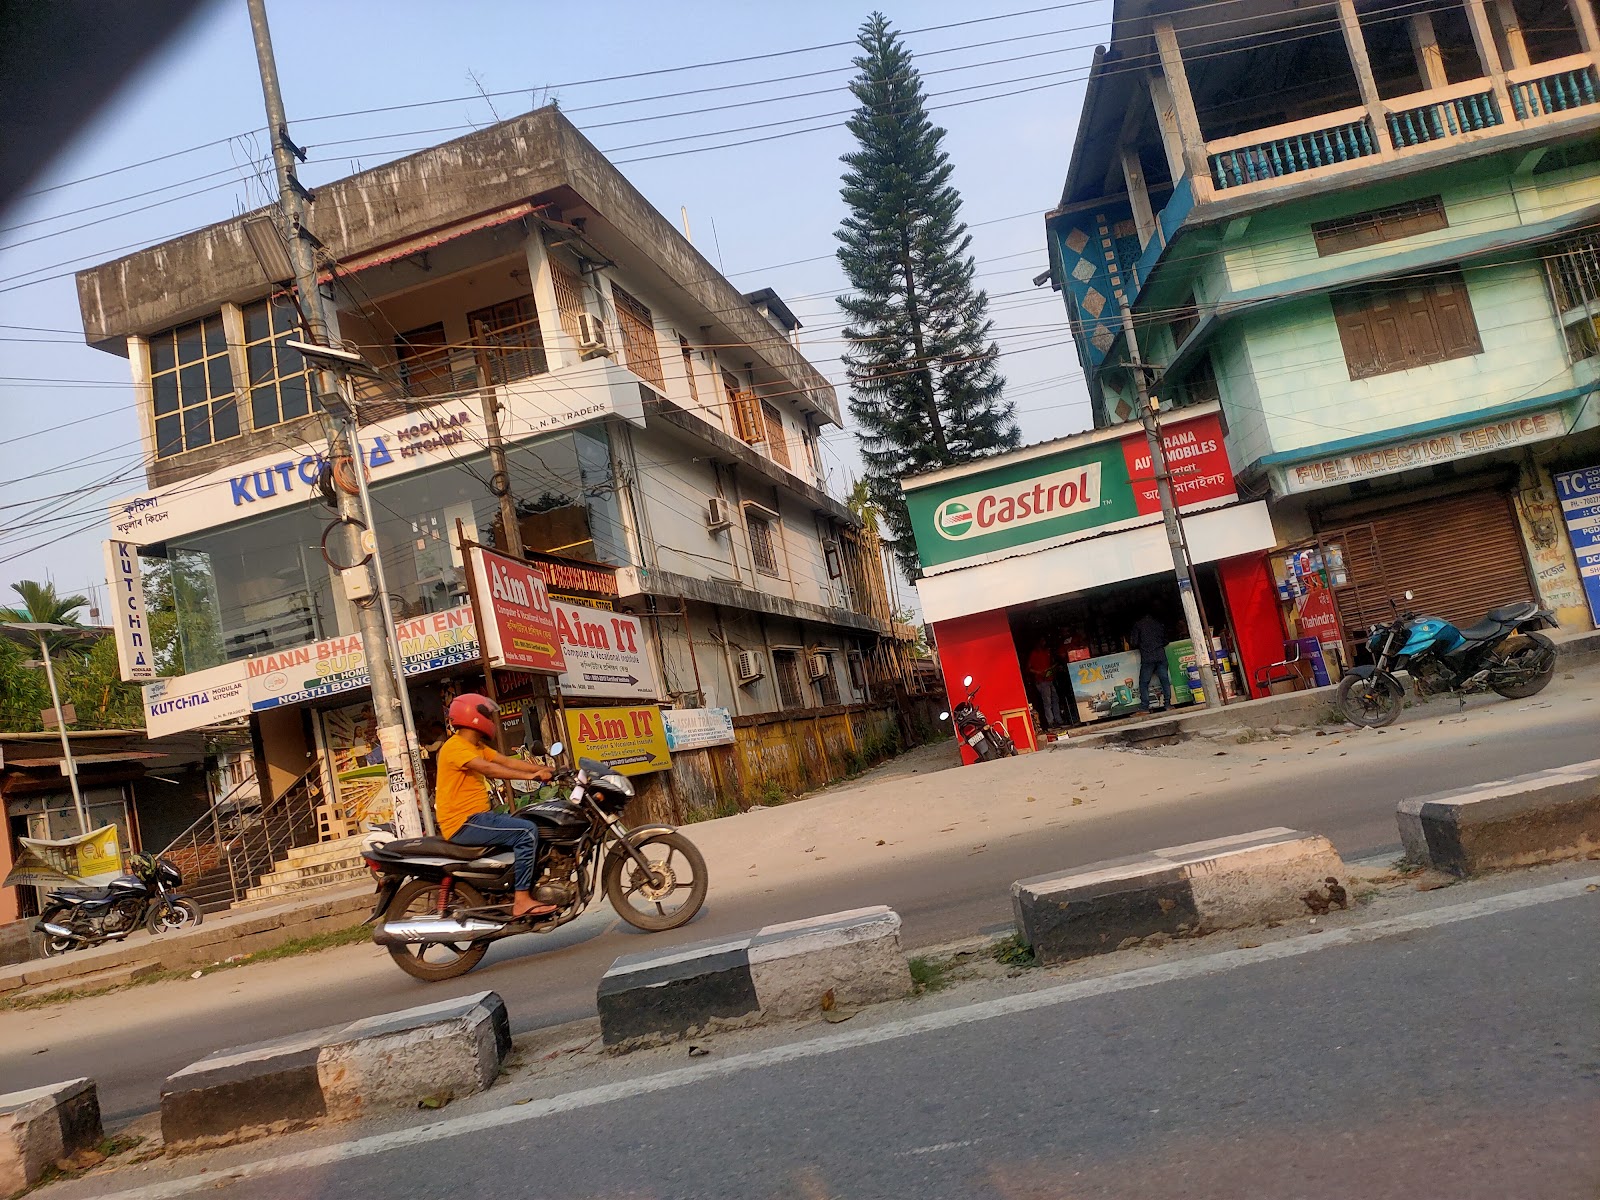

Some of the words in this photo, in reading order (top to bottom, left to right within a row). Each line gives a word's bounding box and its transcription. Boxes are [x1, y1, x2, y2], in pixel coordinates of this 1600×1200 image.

[561, 403, 605, 421] TRADERS
[398, 412, 470, 441] MODULAR
[400, 430, 464, 458] KITCHEN
[1163, 431, 1196, 449] RANA
[1295, 459, 1349, 485] FUEL
[1351, 436, 1457, 472] INJECTION
[1460, 415, 1548, 449] SERVICE
[1557, 473, 1586, 495] TC
[976, 471, 1091, 529] Castrol
[491, 561, 530, 608] Aim
[527, 574, 549, 613] IT
[556, 607, 610, 650] Aim
[610, 618, 638, 654] IT
[1301, 611, 1335, 630] Mahindra
[247, 647, 310, 678] MANN
[320, 674, 341, 685] ALL
[341, 667, 369, 680] HOME
[410, 648, 446, 662] UNDER
[448, 642, 471, 653] ONE
[563, 647, 590, 659] Computer
[595, 650, 620, 662] Vocational
[1078, 666, 1104, 685] 2X
[212, 683, 242, 694] MODULAR
[213, 690, 239, 701] KITCHEN
[278, 684, 327, 704] NORTH
[502, 718, 520, 731] your
[577, 712, 628, 743] Aim
[629, 710, 654, 738] IT
[586, 742, 609, 751] Computer
[615, 740, 636, 748] Vocational
